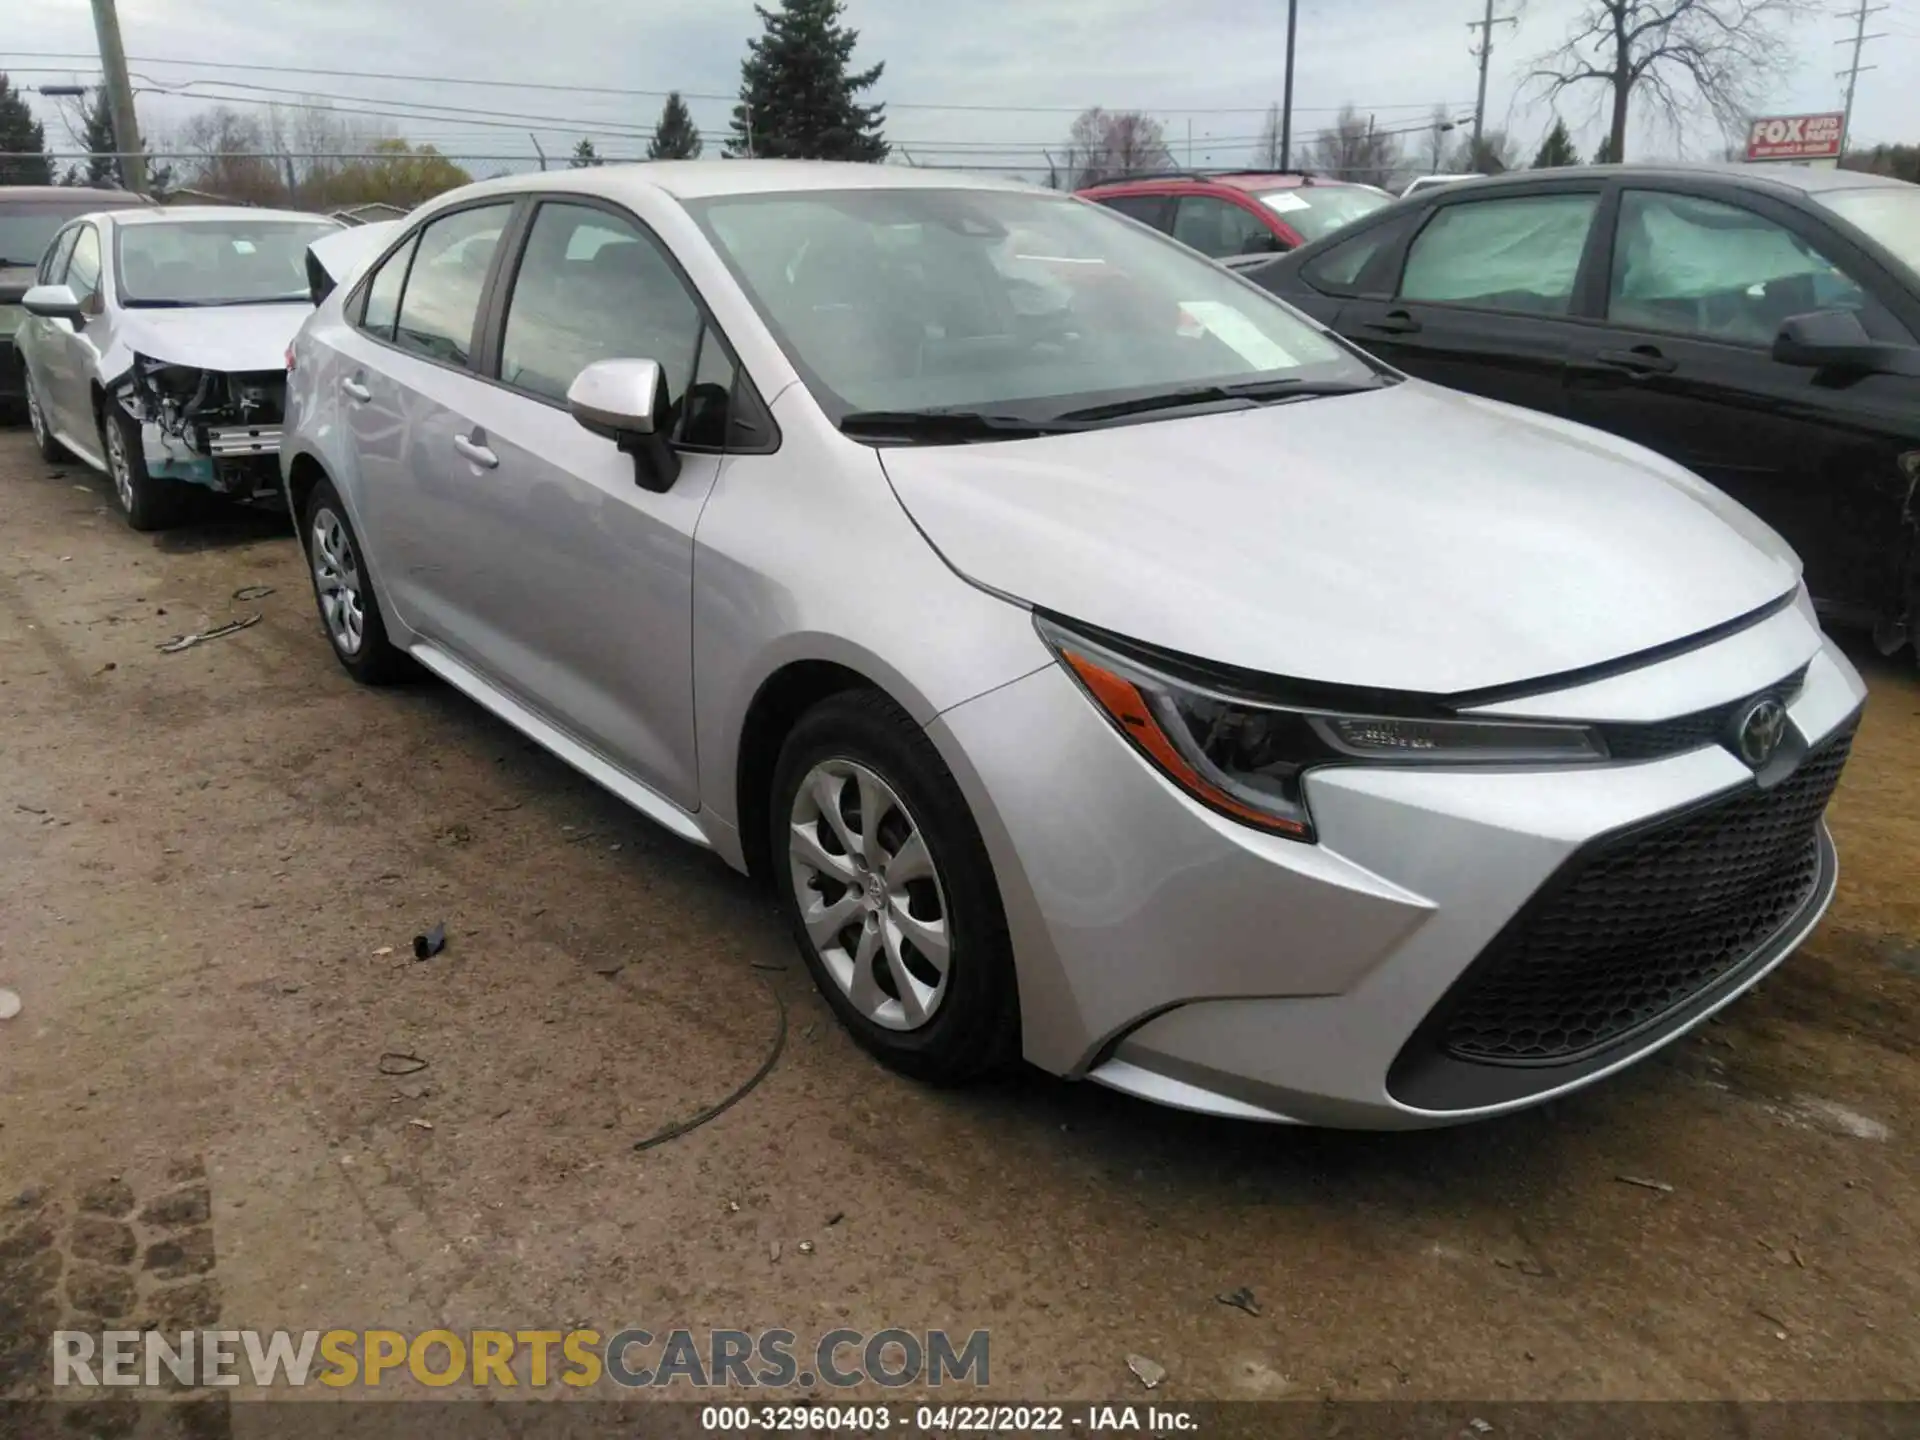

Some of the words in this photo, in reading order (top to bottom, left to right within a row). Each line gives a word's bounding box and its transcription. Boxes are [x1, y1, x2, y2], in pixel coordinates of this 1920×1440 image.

[1807, 118, 1838, 130] AUTO
[1752, 119, 1805, 144] FOX
[1806, 129, 1839, 141] PARTS
